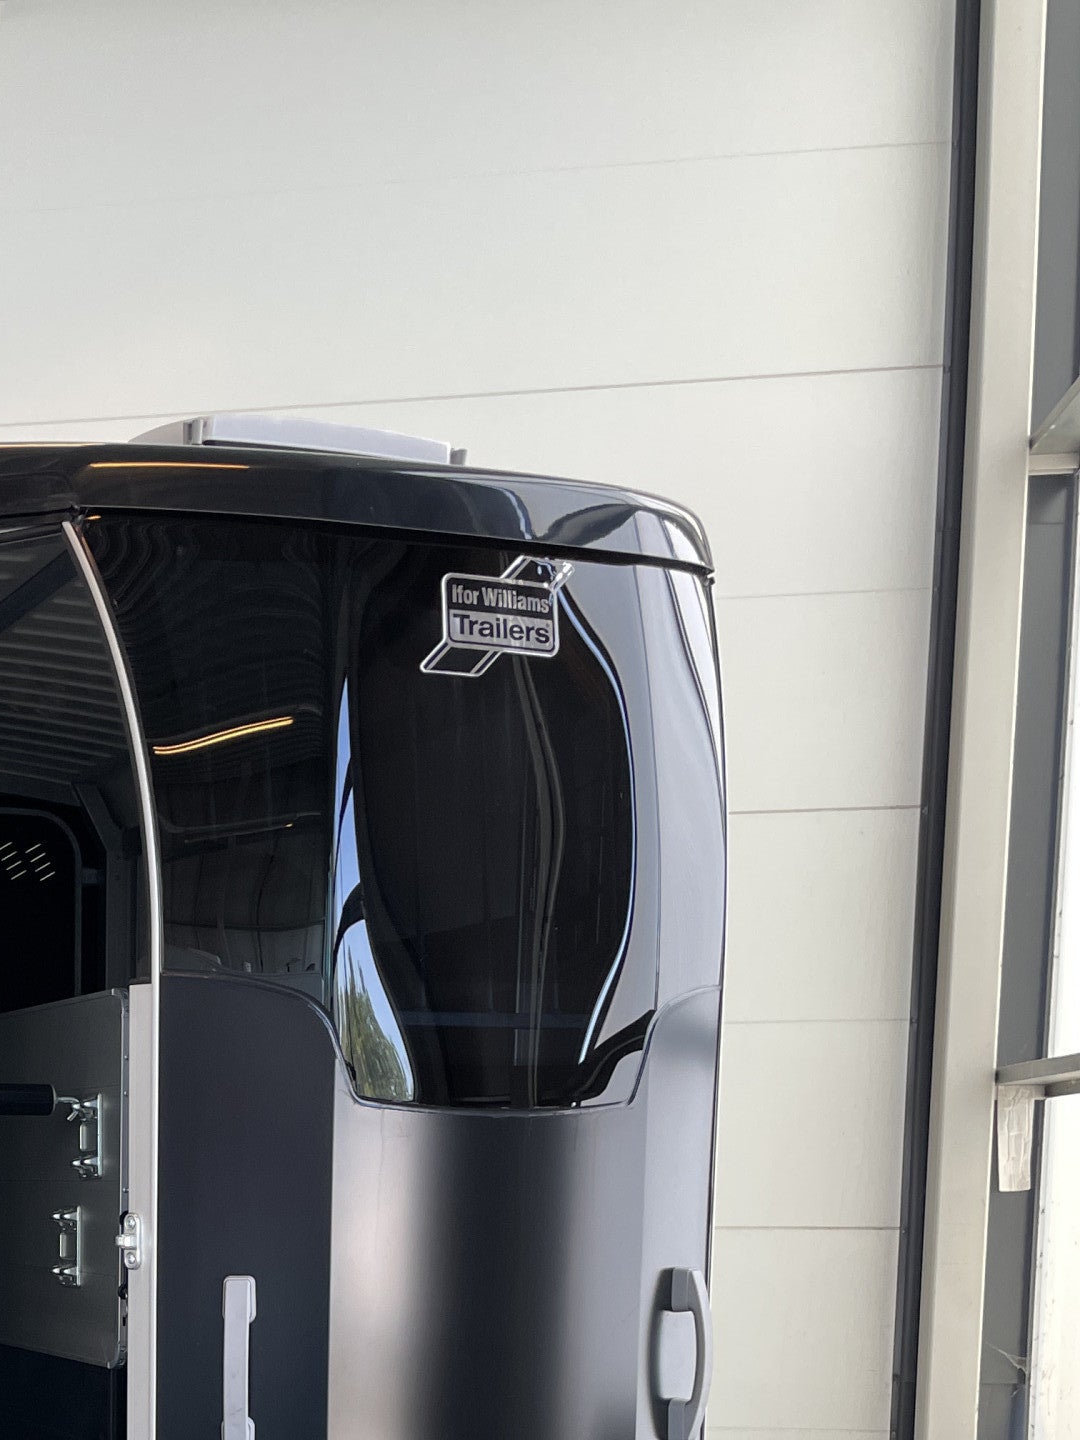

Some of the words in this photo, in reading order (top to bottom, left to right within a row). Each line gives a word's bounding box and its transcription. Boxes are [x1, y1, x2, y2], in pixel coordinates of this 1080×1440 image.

[452, 584, 479, 605] Ifor
[481, 587, 550, 613] Williams
[453, 613, 550, 644] Trailers
